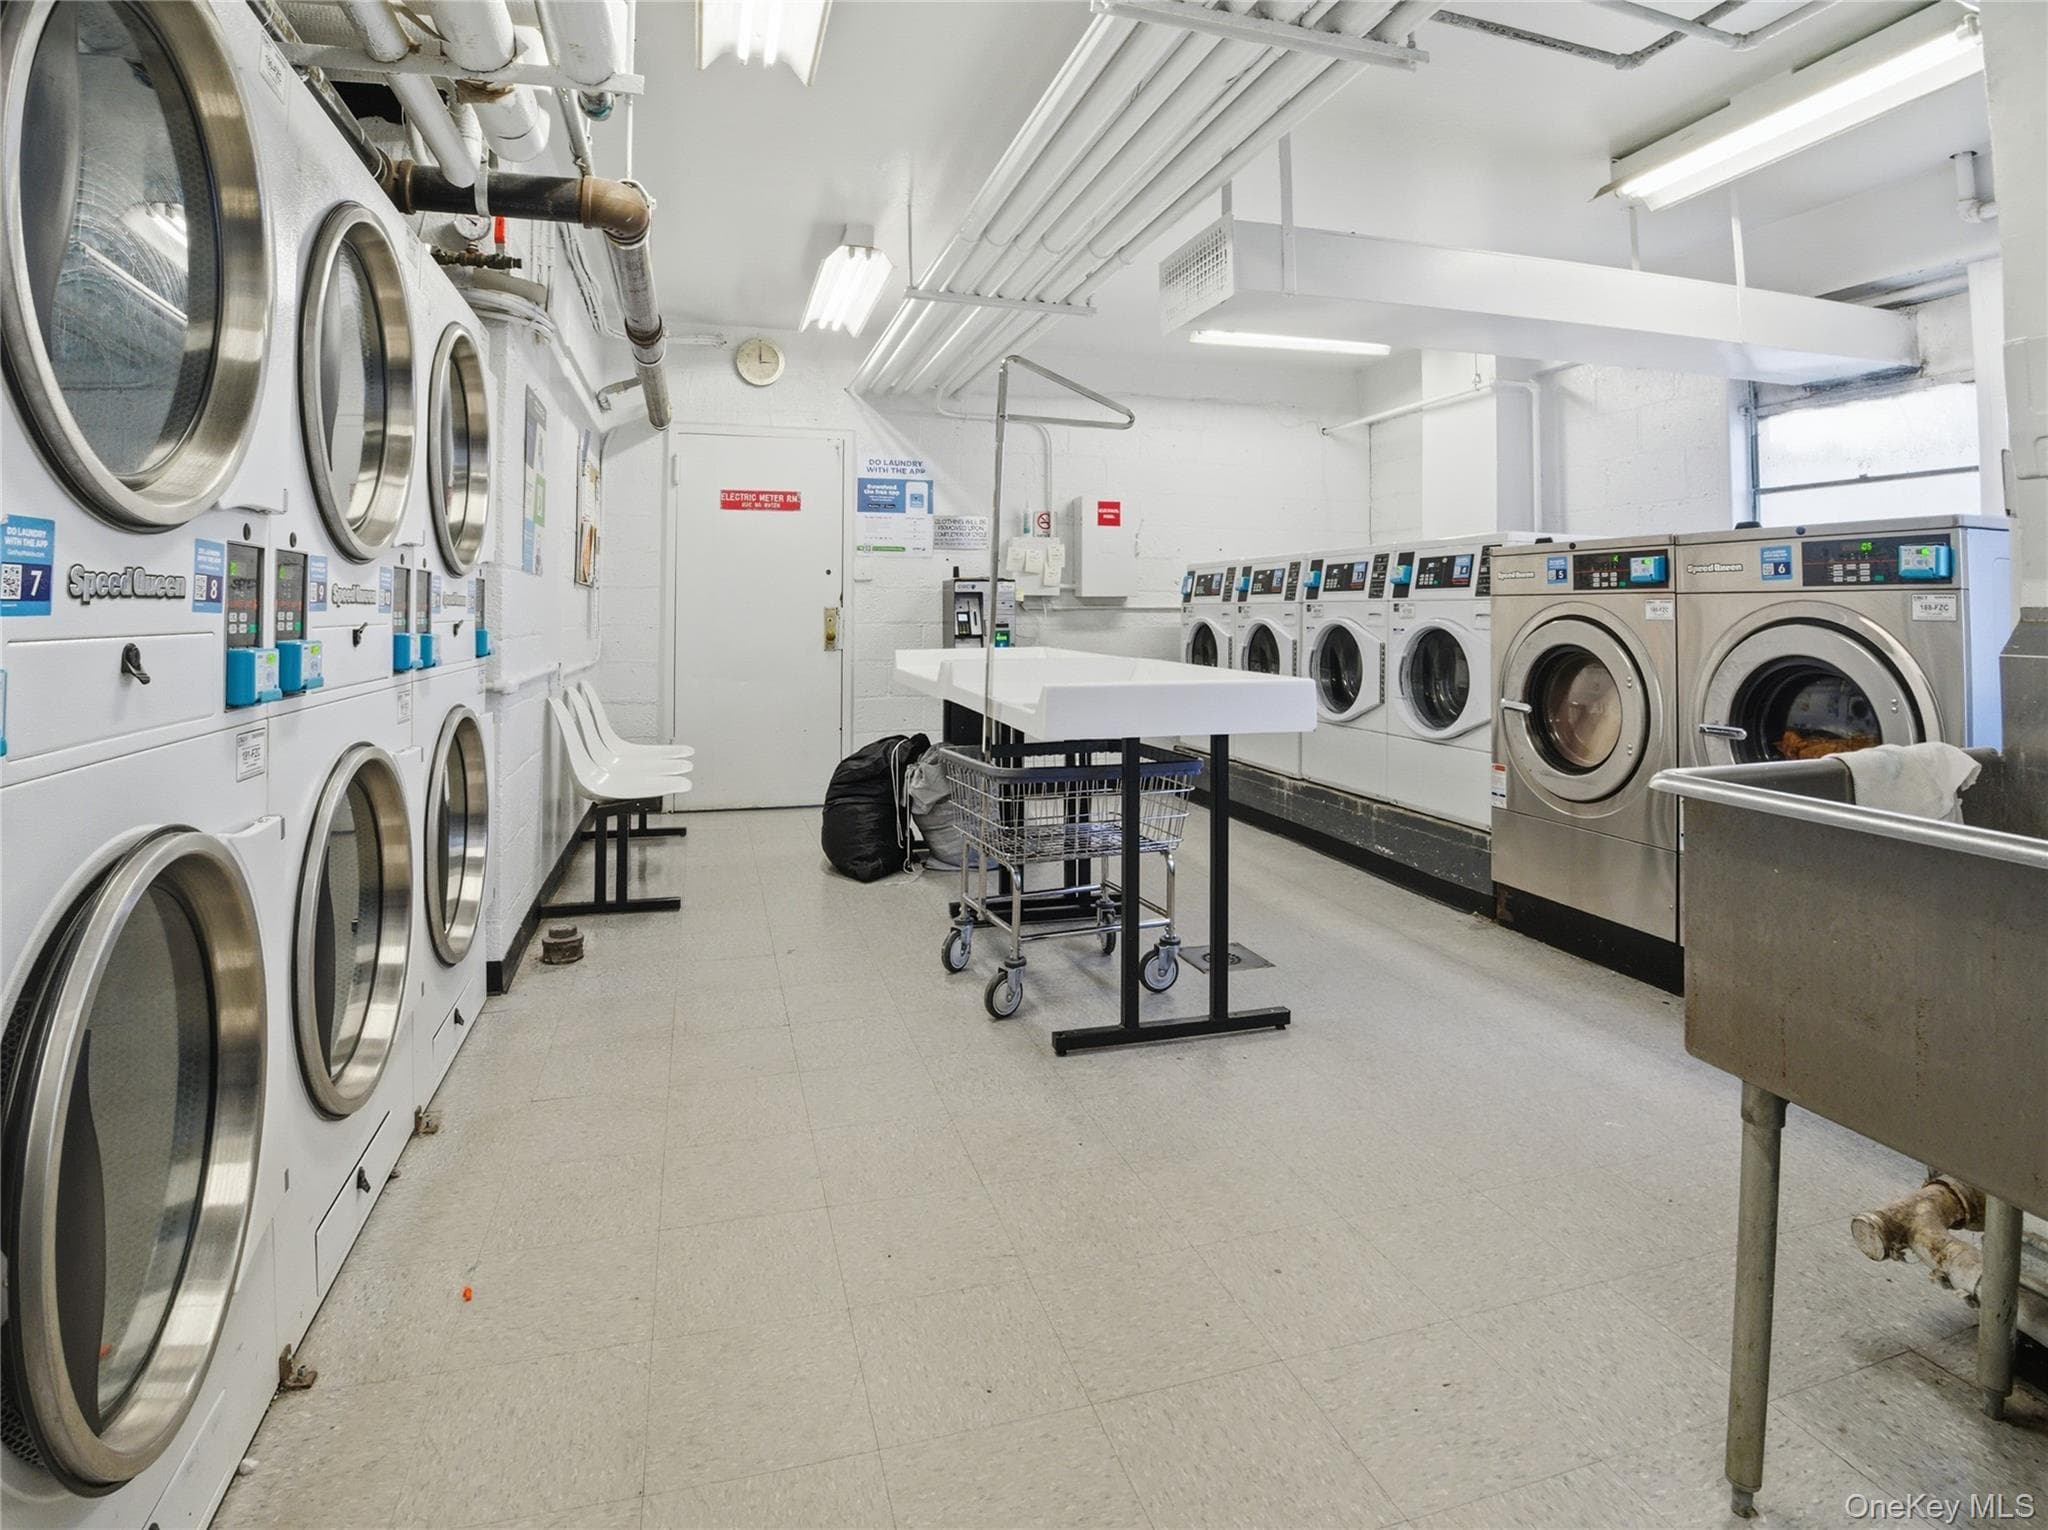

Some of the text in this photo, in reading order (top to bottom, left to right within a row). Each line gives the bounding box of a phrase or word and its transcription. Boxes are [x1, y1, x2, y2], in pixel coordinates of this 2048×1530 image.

[883, 459, 923, 467] LAUNDRY
[866, 466, 889, 474] WITH
[891, 467, 907, 475] THE
[720, 493, 757, 502] ELECTRIC
[760, 494, 784, 503] METER
[6, 526, 47, 539] DO LAUNDRY
[4, 536, 49, 549] WITH THE APP
[1557, 570, 1565, 579] 5
[1687, 562, 1744, 575] Speed Queen
[1777, 563, 1786, 575] 6
[30, 570, 42, 597] 7
[68, 563, 186, 605] Speed Queen
[210, 579, 218, 600] 8
[318, 584, 325, 601] 9
[331, 583, 356, 608] Speed
